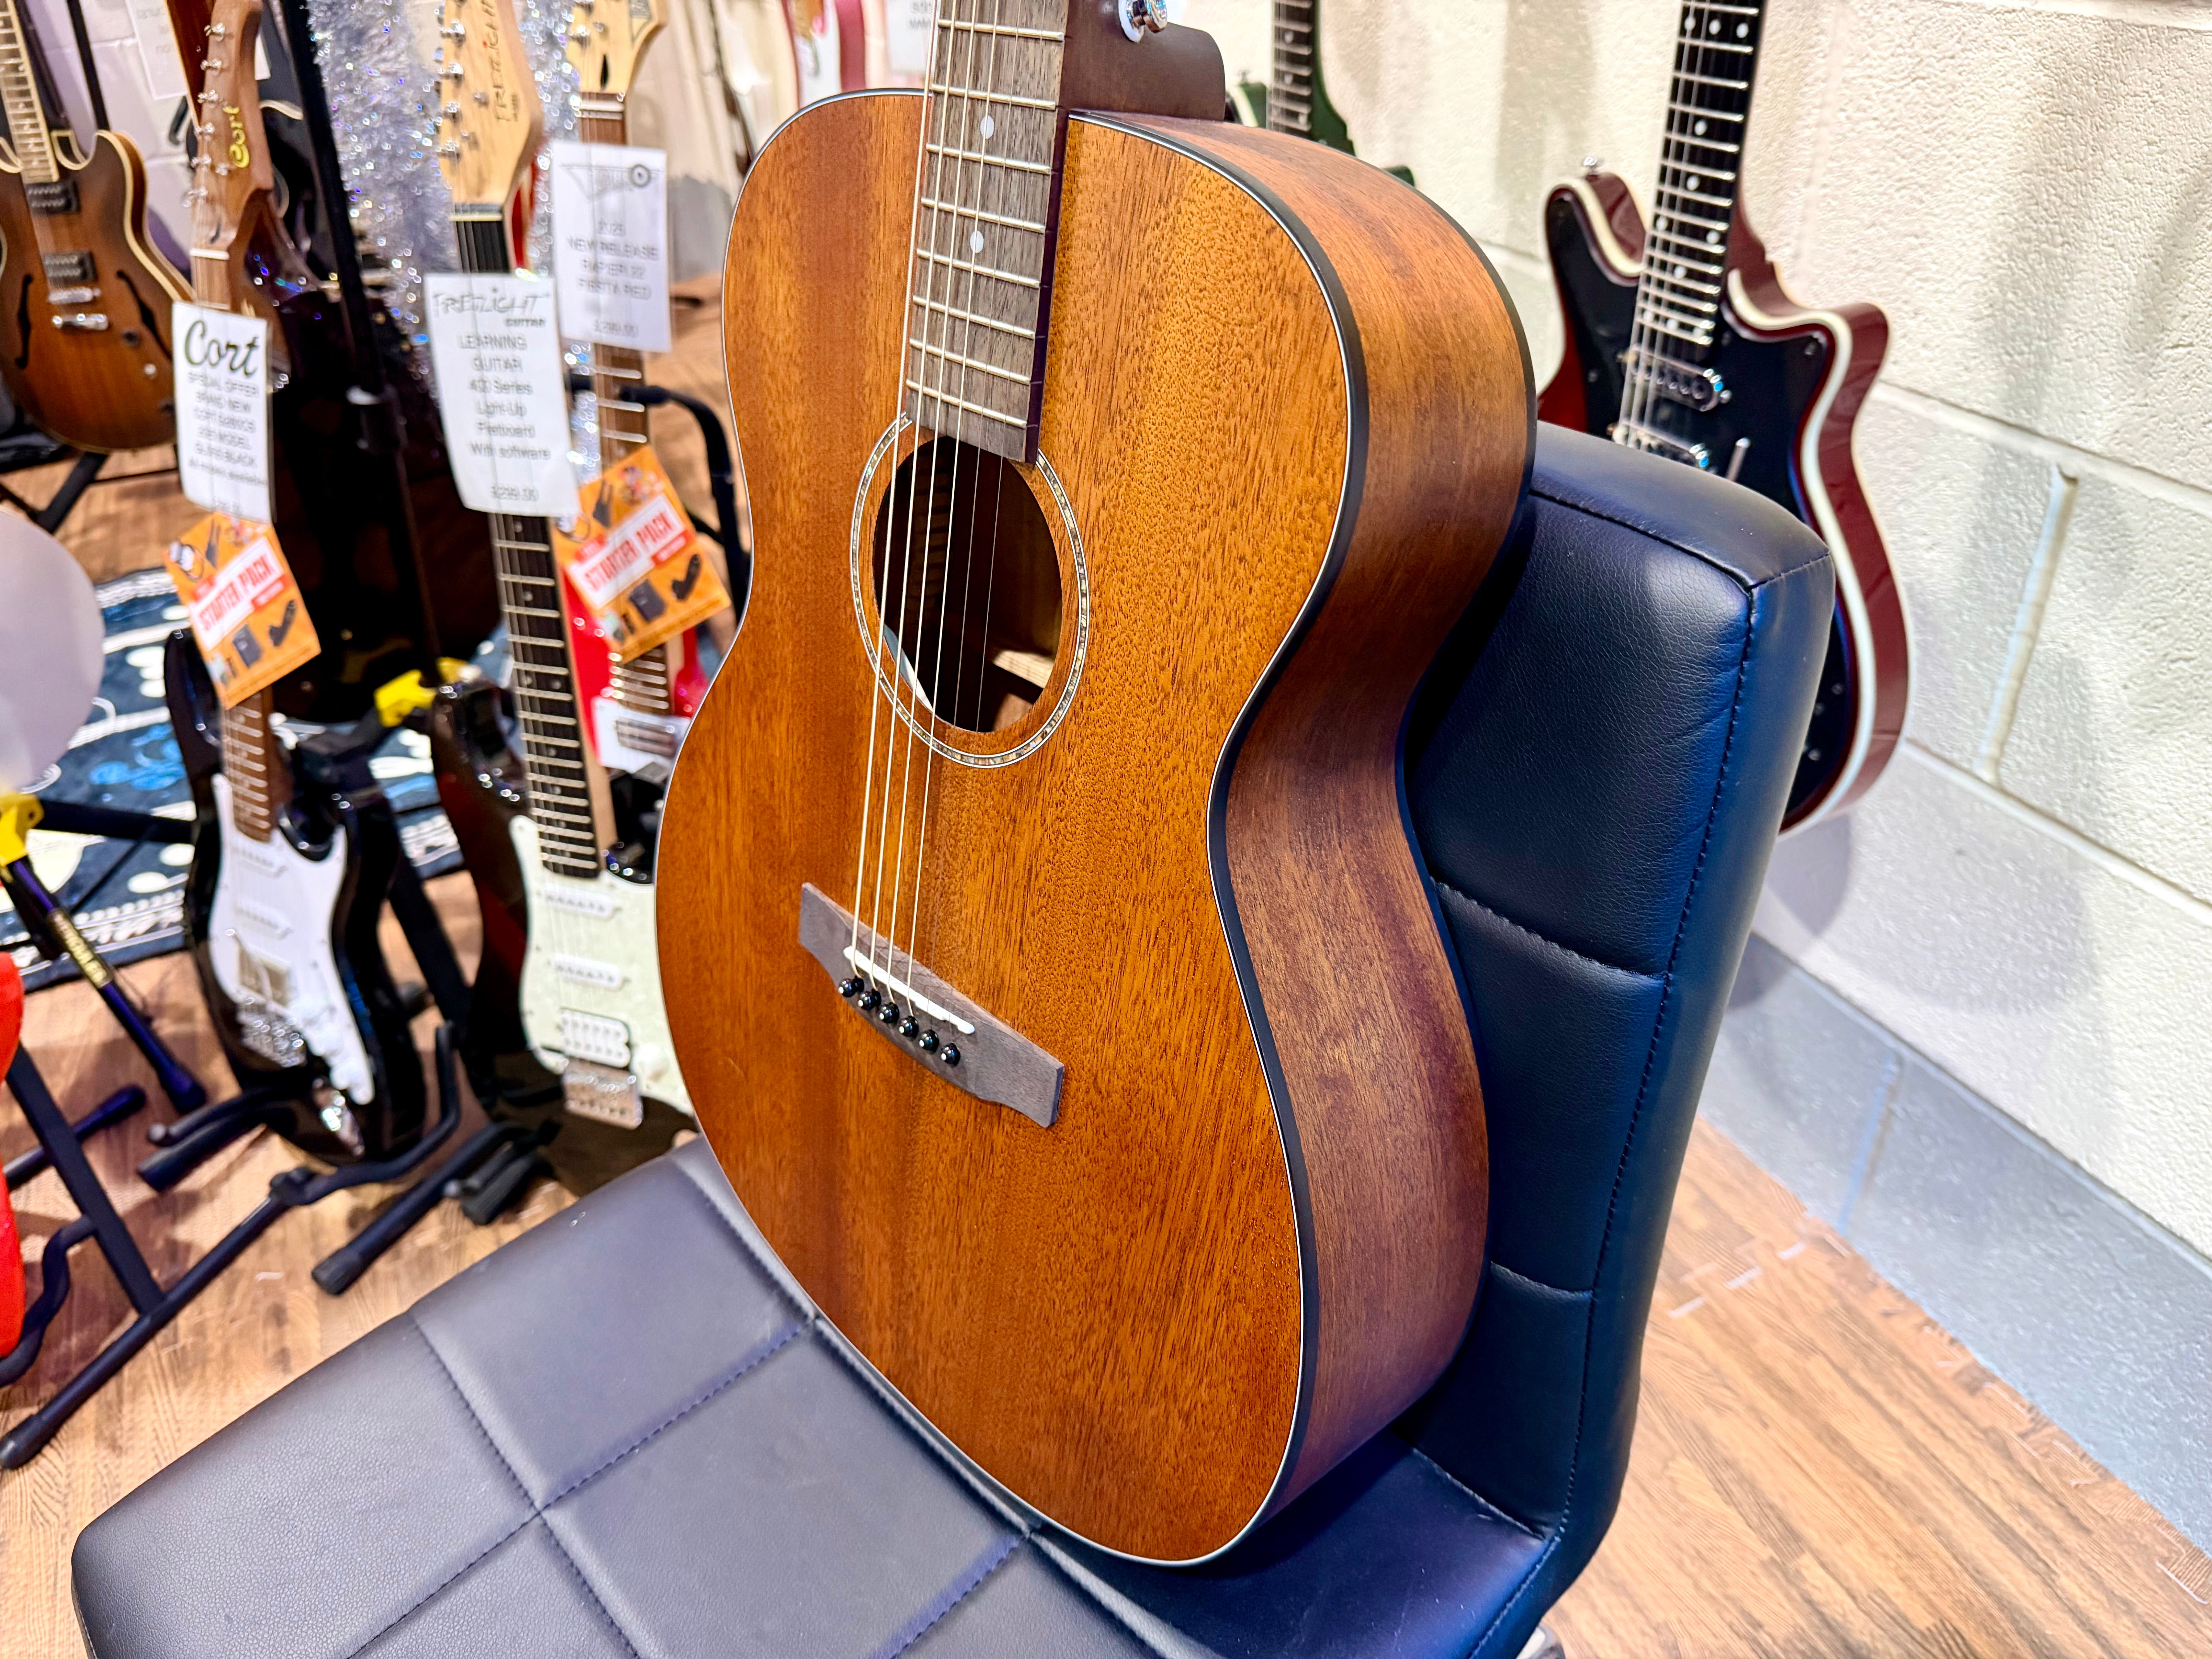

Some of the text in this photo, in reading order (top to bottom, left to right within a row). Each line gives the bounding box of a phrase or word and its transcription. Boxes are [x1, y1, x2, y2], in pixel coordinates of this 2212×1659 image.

[222, 105, 250, 168] Cort
[567, 237, 659, 260] NEW RELEASE
[184, 319, 260, 377] Cort
[458, 335, 527, 350] LEARNING
[471, 356, 522, 372] GUITAR
[493, 379, 533, 395] Series
[471, 442, 551, 460] With software
[584, 539, 640, 592] STARTER
[635, 511, 673, 552] PACK
[199, 580, 243, 633] STARTER
[237, 554, 275, 595] PACK
